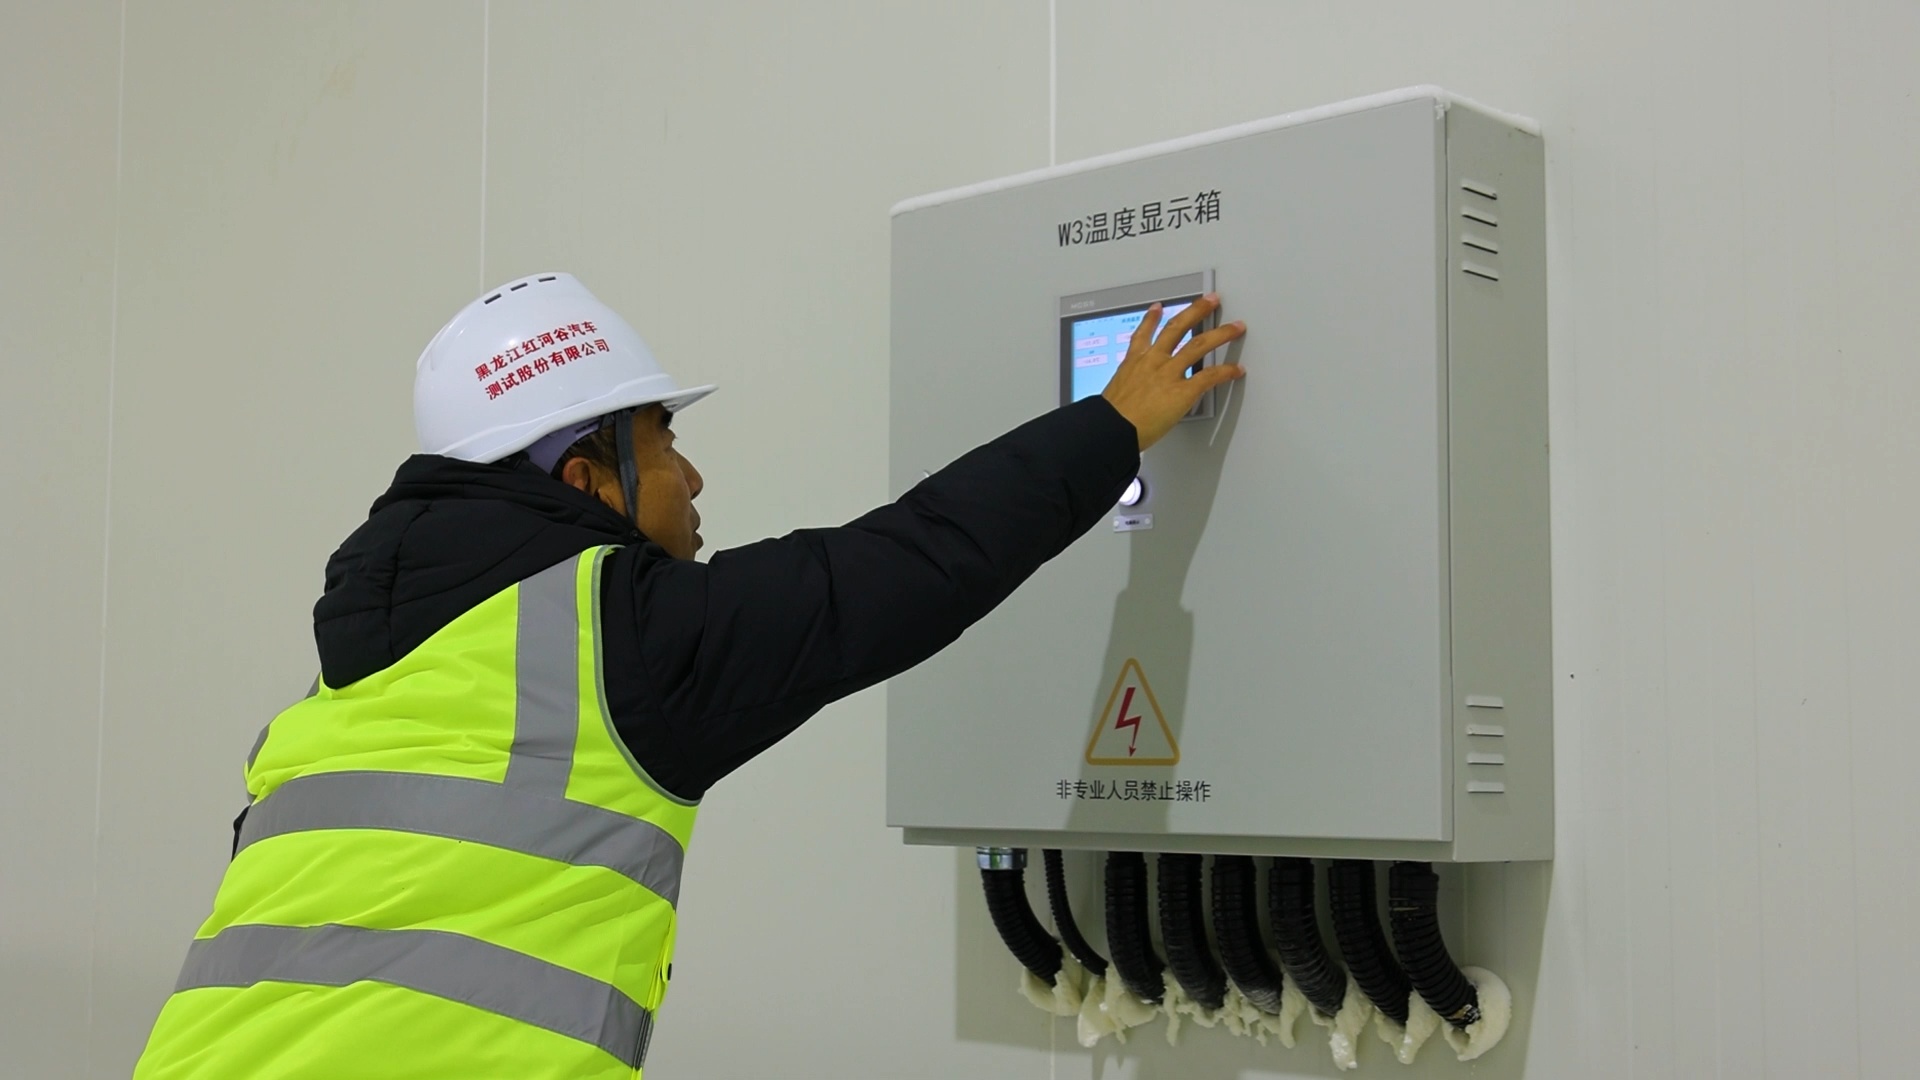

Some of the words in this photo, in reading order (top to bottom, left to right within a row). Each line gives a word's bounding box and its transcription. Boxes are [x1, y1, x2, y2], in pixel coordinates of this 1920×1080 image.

[1058, 189, 1222, 247] W3温度显示箱
[475, 320, 598, 382] 黑龙江红河谷汽车
[484, 338, 610, 401] 测试股份有限公司
[1056, 779, 1212, 802] 非专业人员禁止操作
